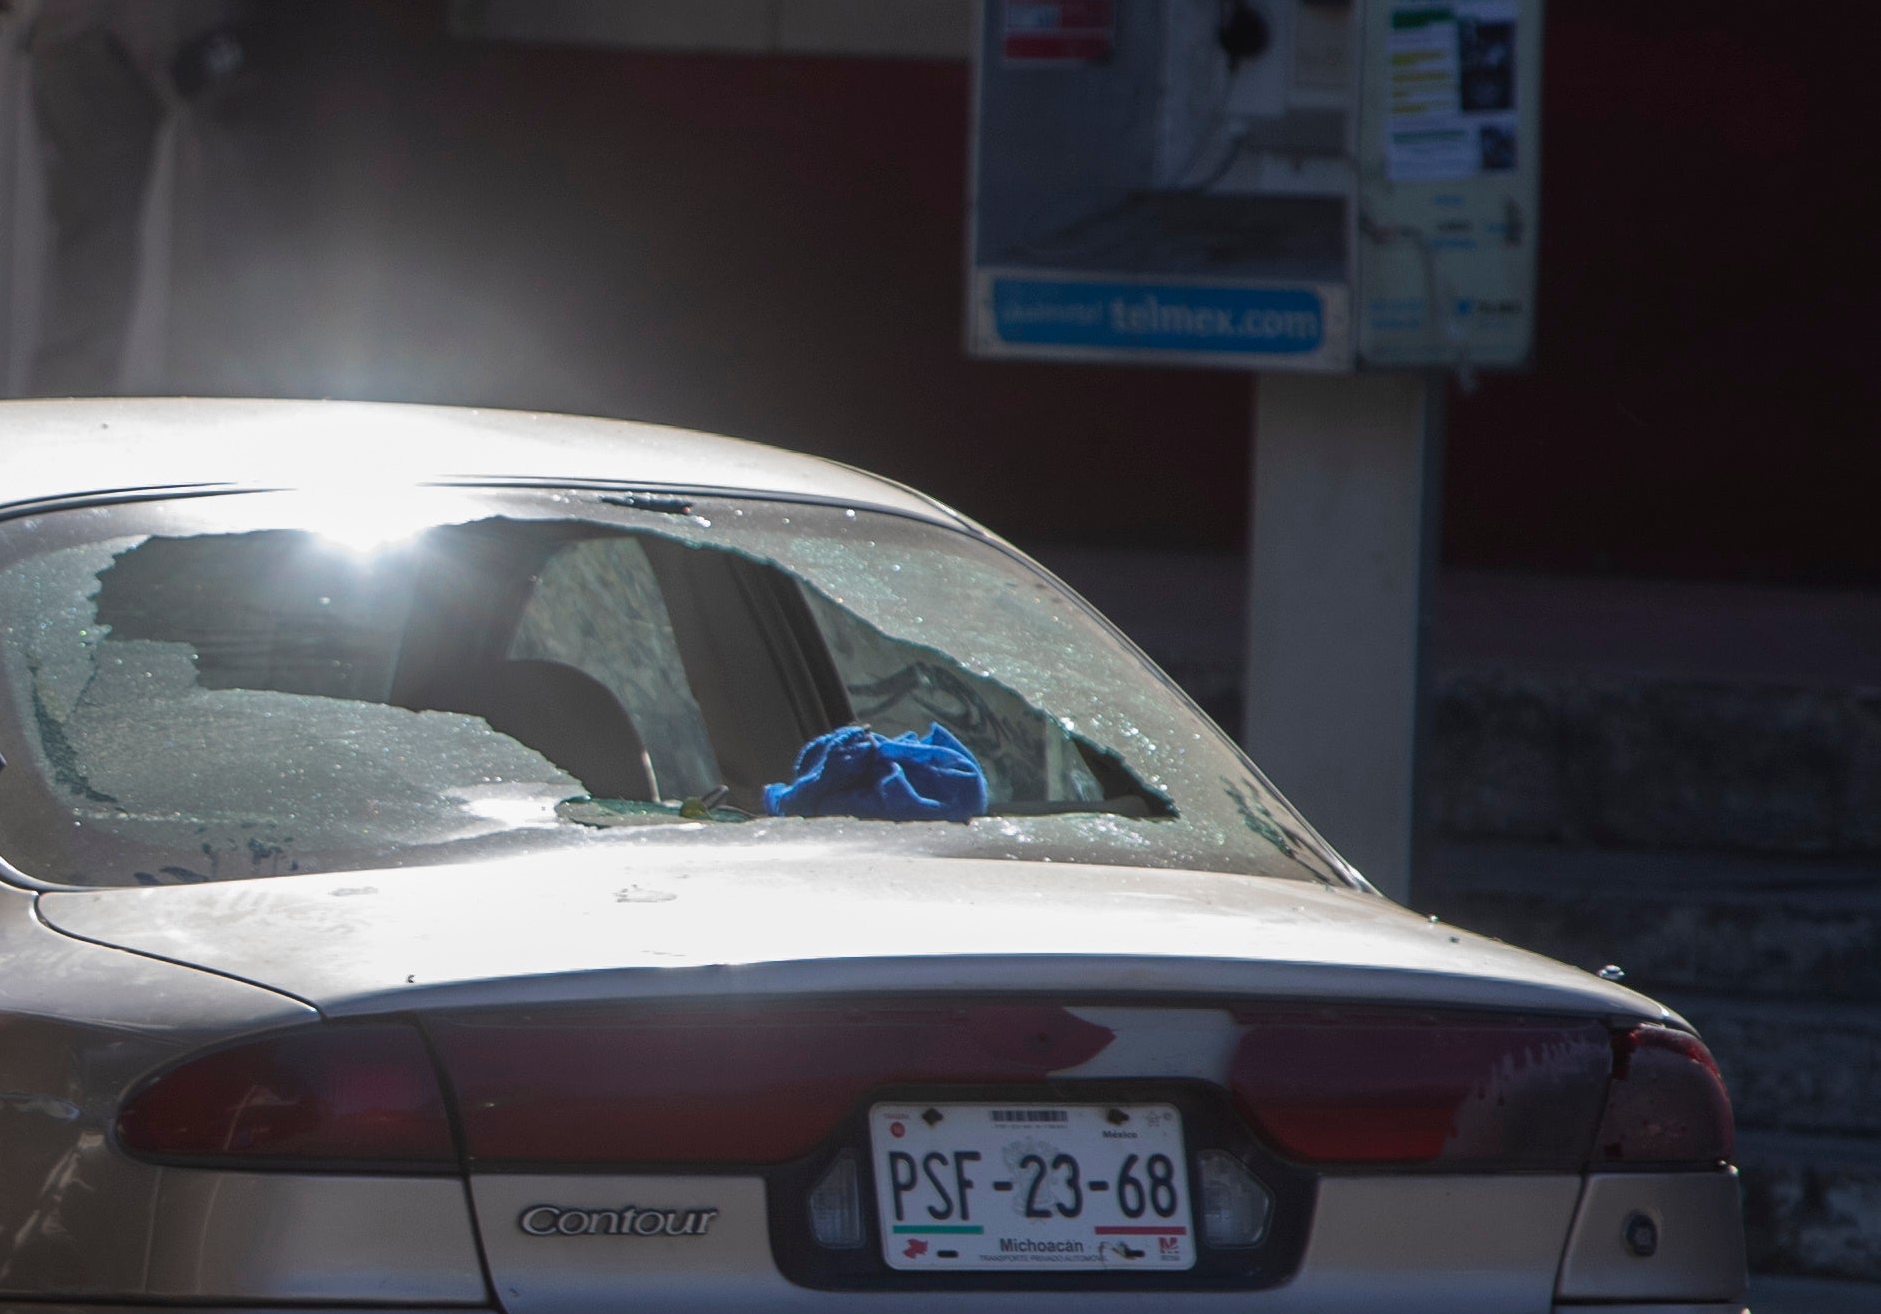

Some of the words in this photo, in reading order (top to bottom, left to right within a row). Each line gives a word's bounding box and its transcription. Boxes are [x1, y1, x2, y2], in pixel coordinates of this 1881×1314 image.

[1111, 295, 1316, 339] telmex.com
[1103, 1129, 1137, 1139] México
[889, 1151, 1178, 1222] PSF-23-68
[519, 1202, 719, 1236] Contour
[1000, 1237, 1084, 1252] Michoacán
